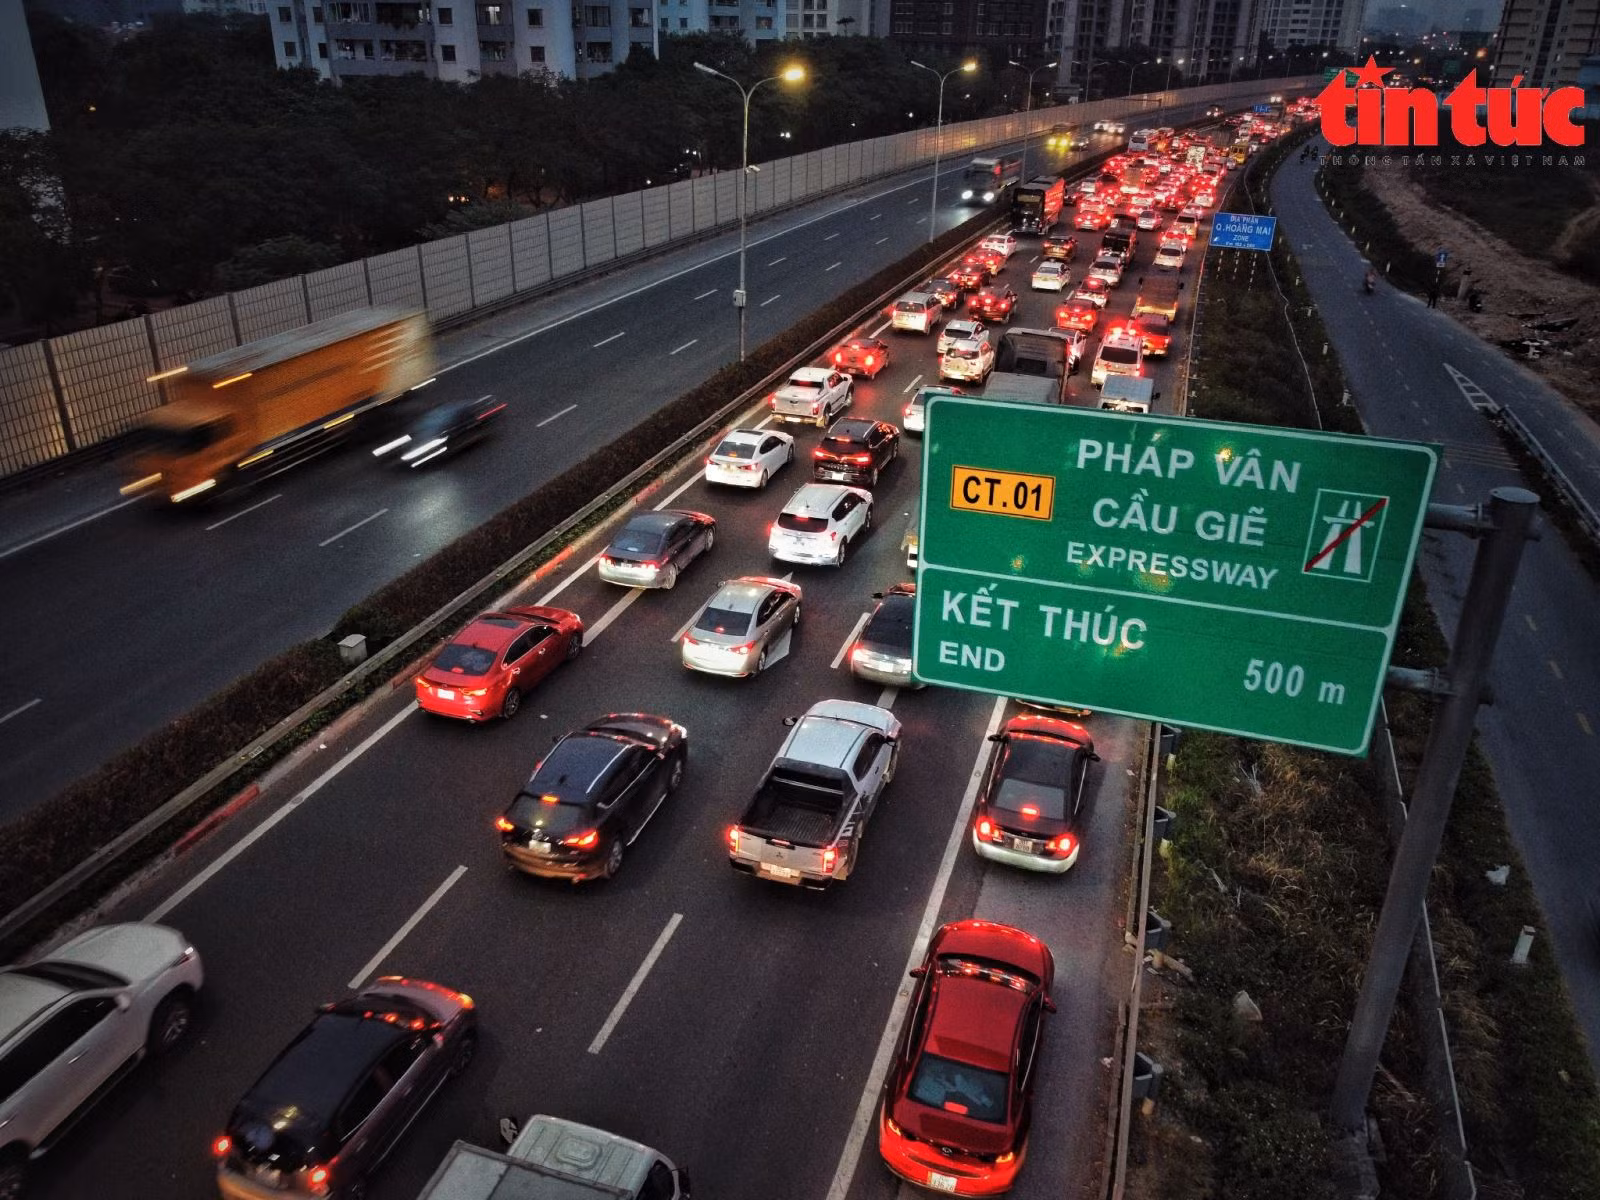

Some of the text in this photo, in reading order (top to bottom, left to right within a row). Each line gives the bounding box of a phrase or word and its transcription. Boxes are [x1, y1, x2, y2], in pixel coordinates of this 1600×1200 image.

[1233, 234, 1249, 242] ZONE
[1255, 226, 1271, 235] MAI
[1076, 433, 1301, 494] PHÁP VÂN
[962, 475, 1042, 512] CT.01
[1092, 488, 1269, 547] CẦU GIẼ
[1066, 541, 1278, 590] EXPRESSWAY
[941, 583, 1148, 650] KẾT THÚC
[939, 641, 1006, 672] END
[1243, 658, 1346, 704] 500 m
